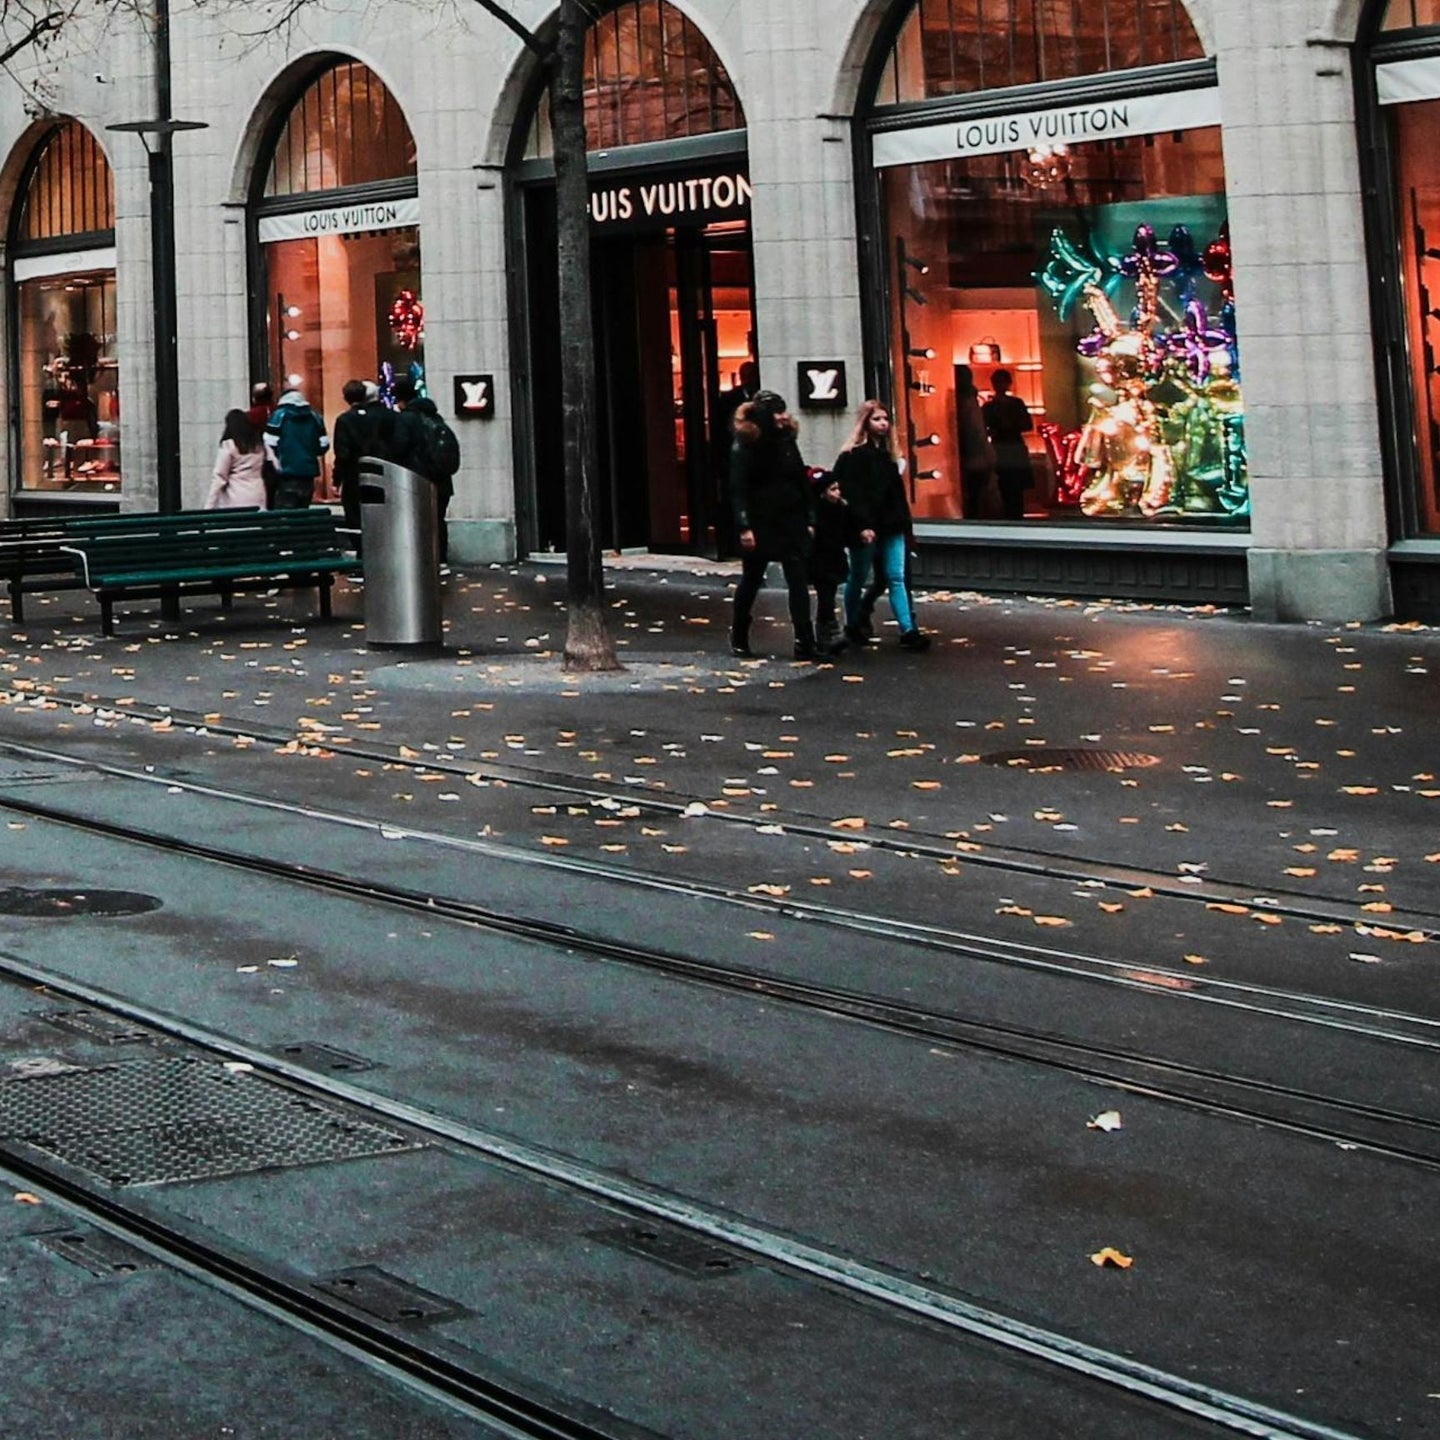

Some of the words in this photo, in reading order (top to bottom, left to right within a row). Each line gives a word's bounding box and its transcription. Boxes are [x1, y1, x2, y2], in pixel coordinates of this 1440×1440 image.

[957, 120, 1019, 149] LOUIS
[1029, 106, 1129, 138] VUITTON
[304, 213, 339, 232] LOUIS
[342, 206, 397, 227] VUITTON
[586, 187, 633, 222] UIS
[640, 173, 754, 216] VUITTON
